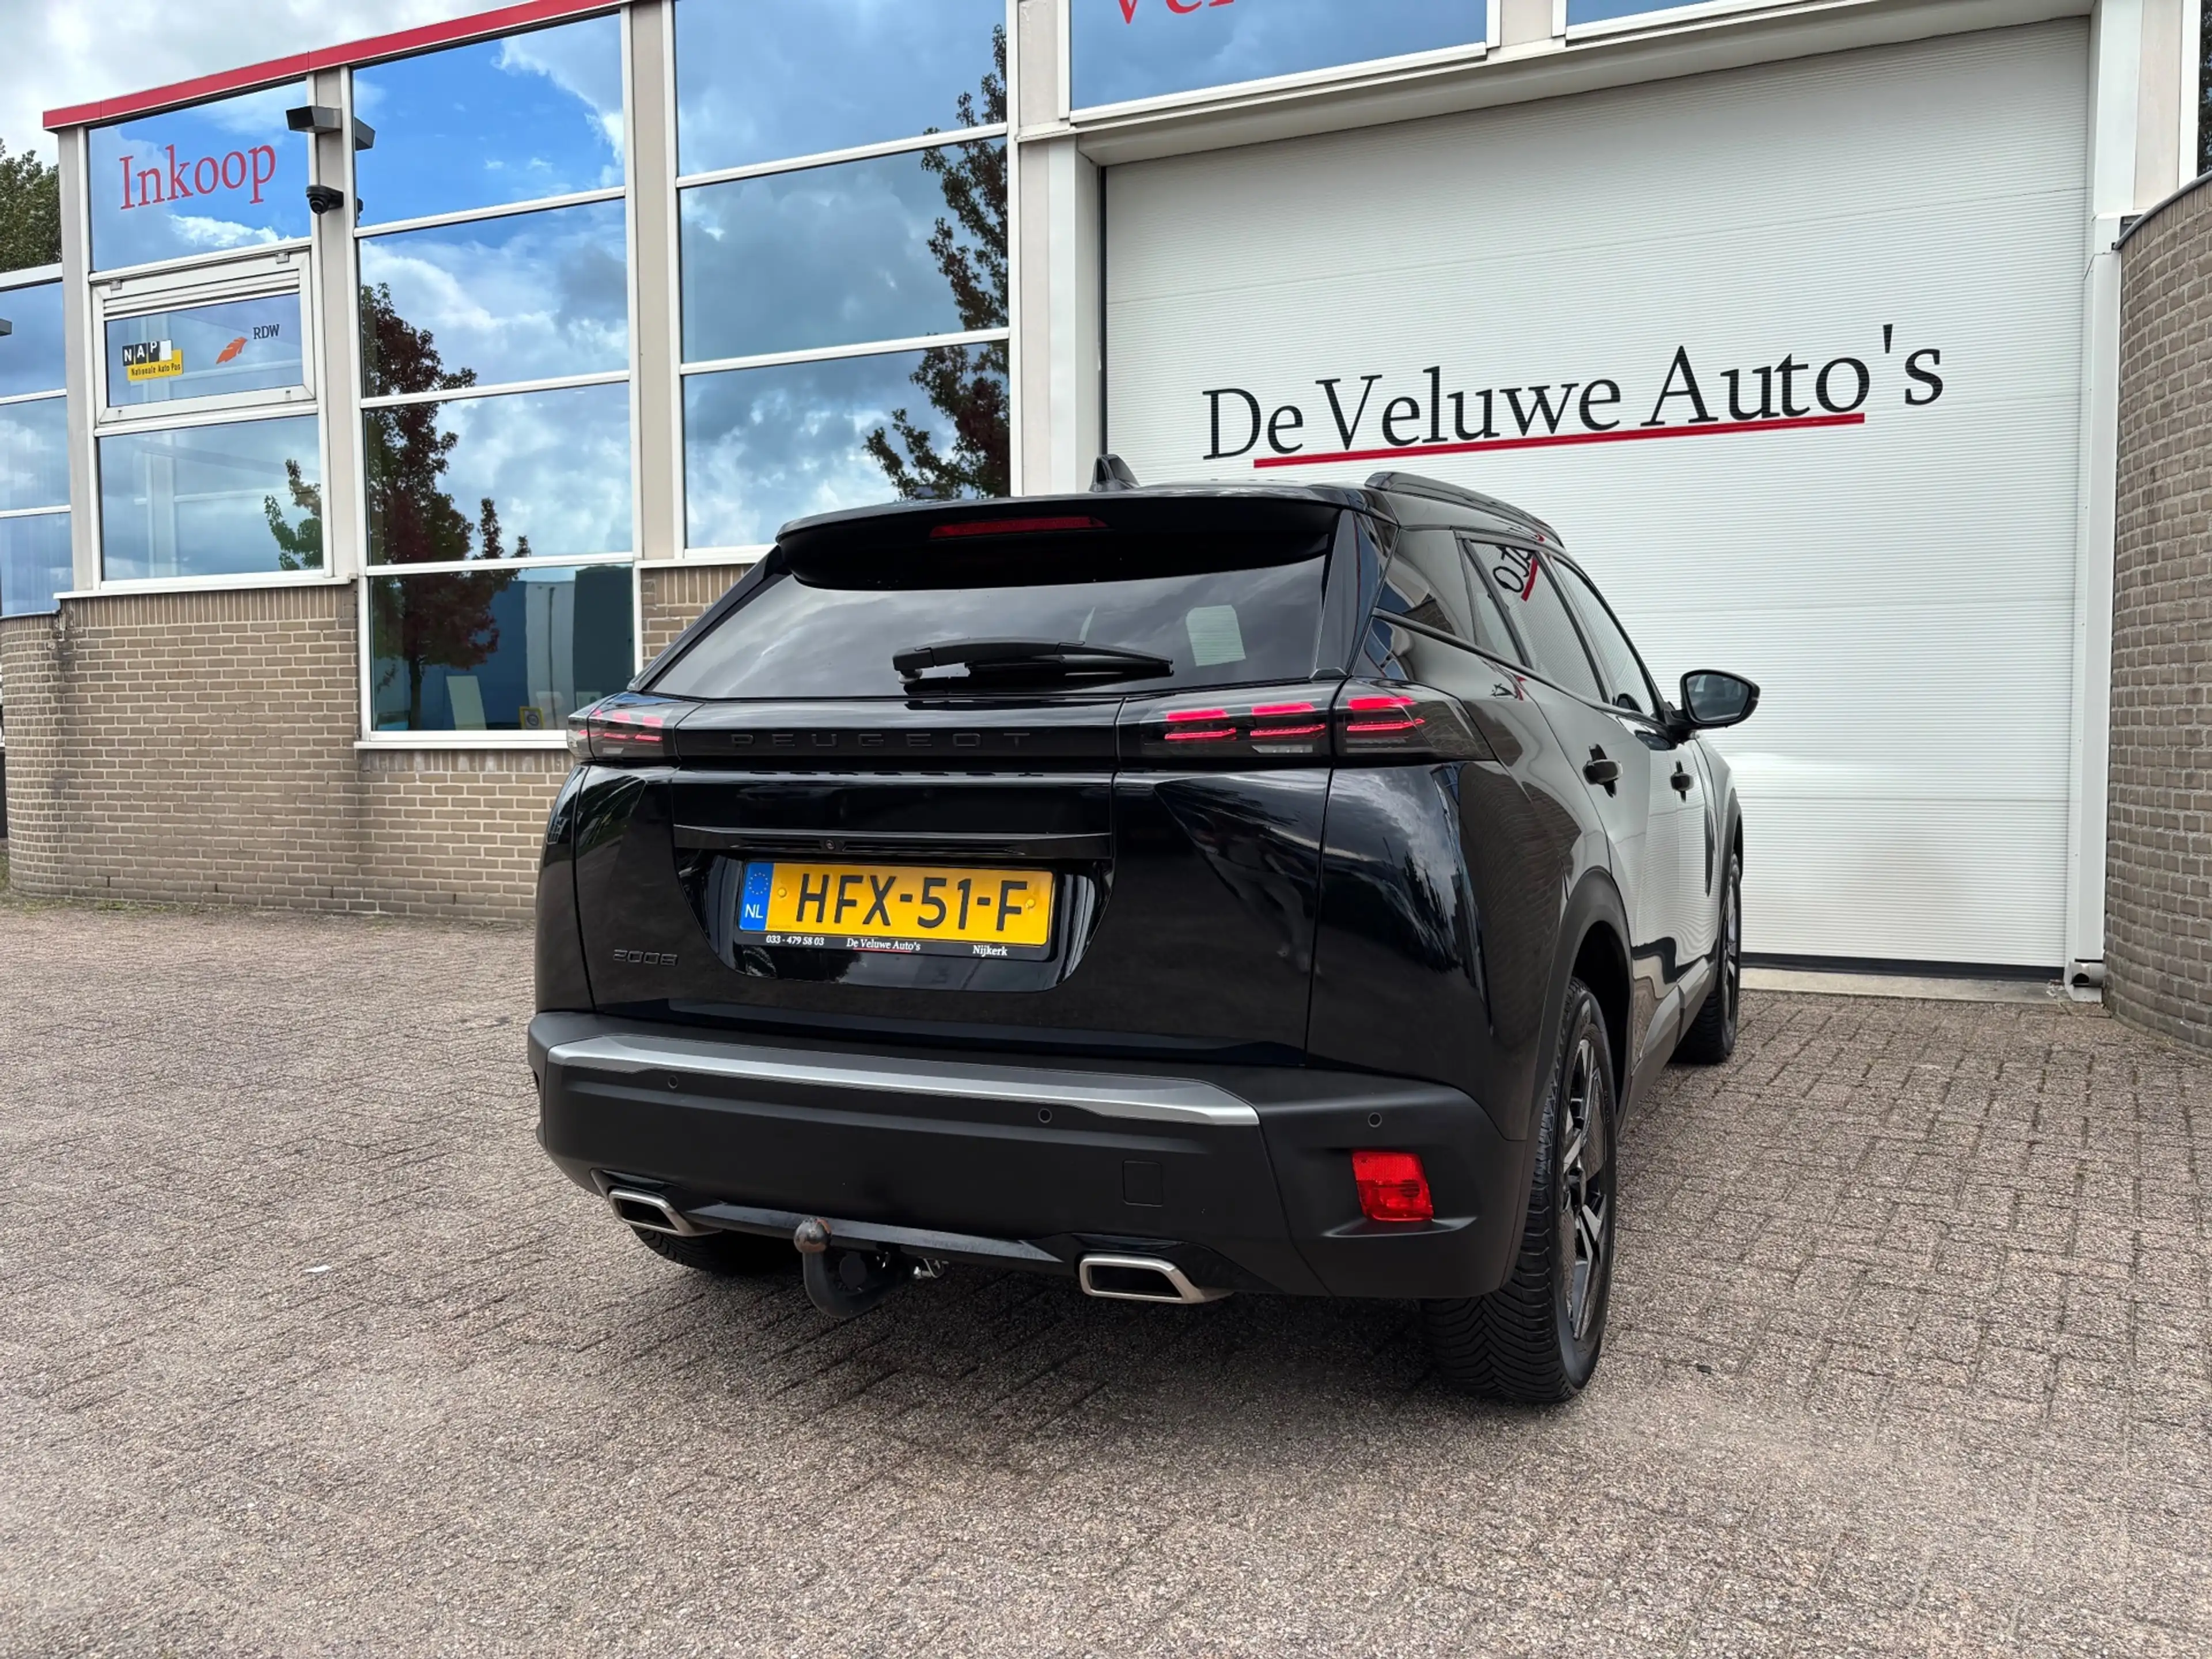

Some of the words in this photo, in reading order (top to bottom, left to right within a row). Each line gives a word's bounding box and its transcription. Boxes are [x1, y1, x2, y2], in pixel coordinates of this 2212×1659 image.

[119, 143, 276, 209] Inkoop
[253, 324, 280, 339] RDW
[124, 341, 158, 362] NAP
[158, 364, 170, 373] Auto
[1202, 388, 1304, 460] De
[1315, 367, 1621, 451] Veluwe
[1640, 324, 1944, 427] Auto's
[730, 733, 1031, 747] PEUGEOT
[796, 873, 1028, 932] HFX-51-F
[745, 903, 763, 918] NL
[766, 935, 781, 944] 033
[787, 935, 801, 945] 479
[802, 937, 812, 946] 58
[813, 937, 824, 946] 03
[846, 938, 858, 948] De
[859, 938, 891, 950] Veluwe
[892, 941, 921, 951] Auto's
[972, 945, 1007, 957] Nijkerk
